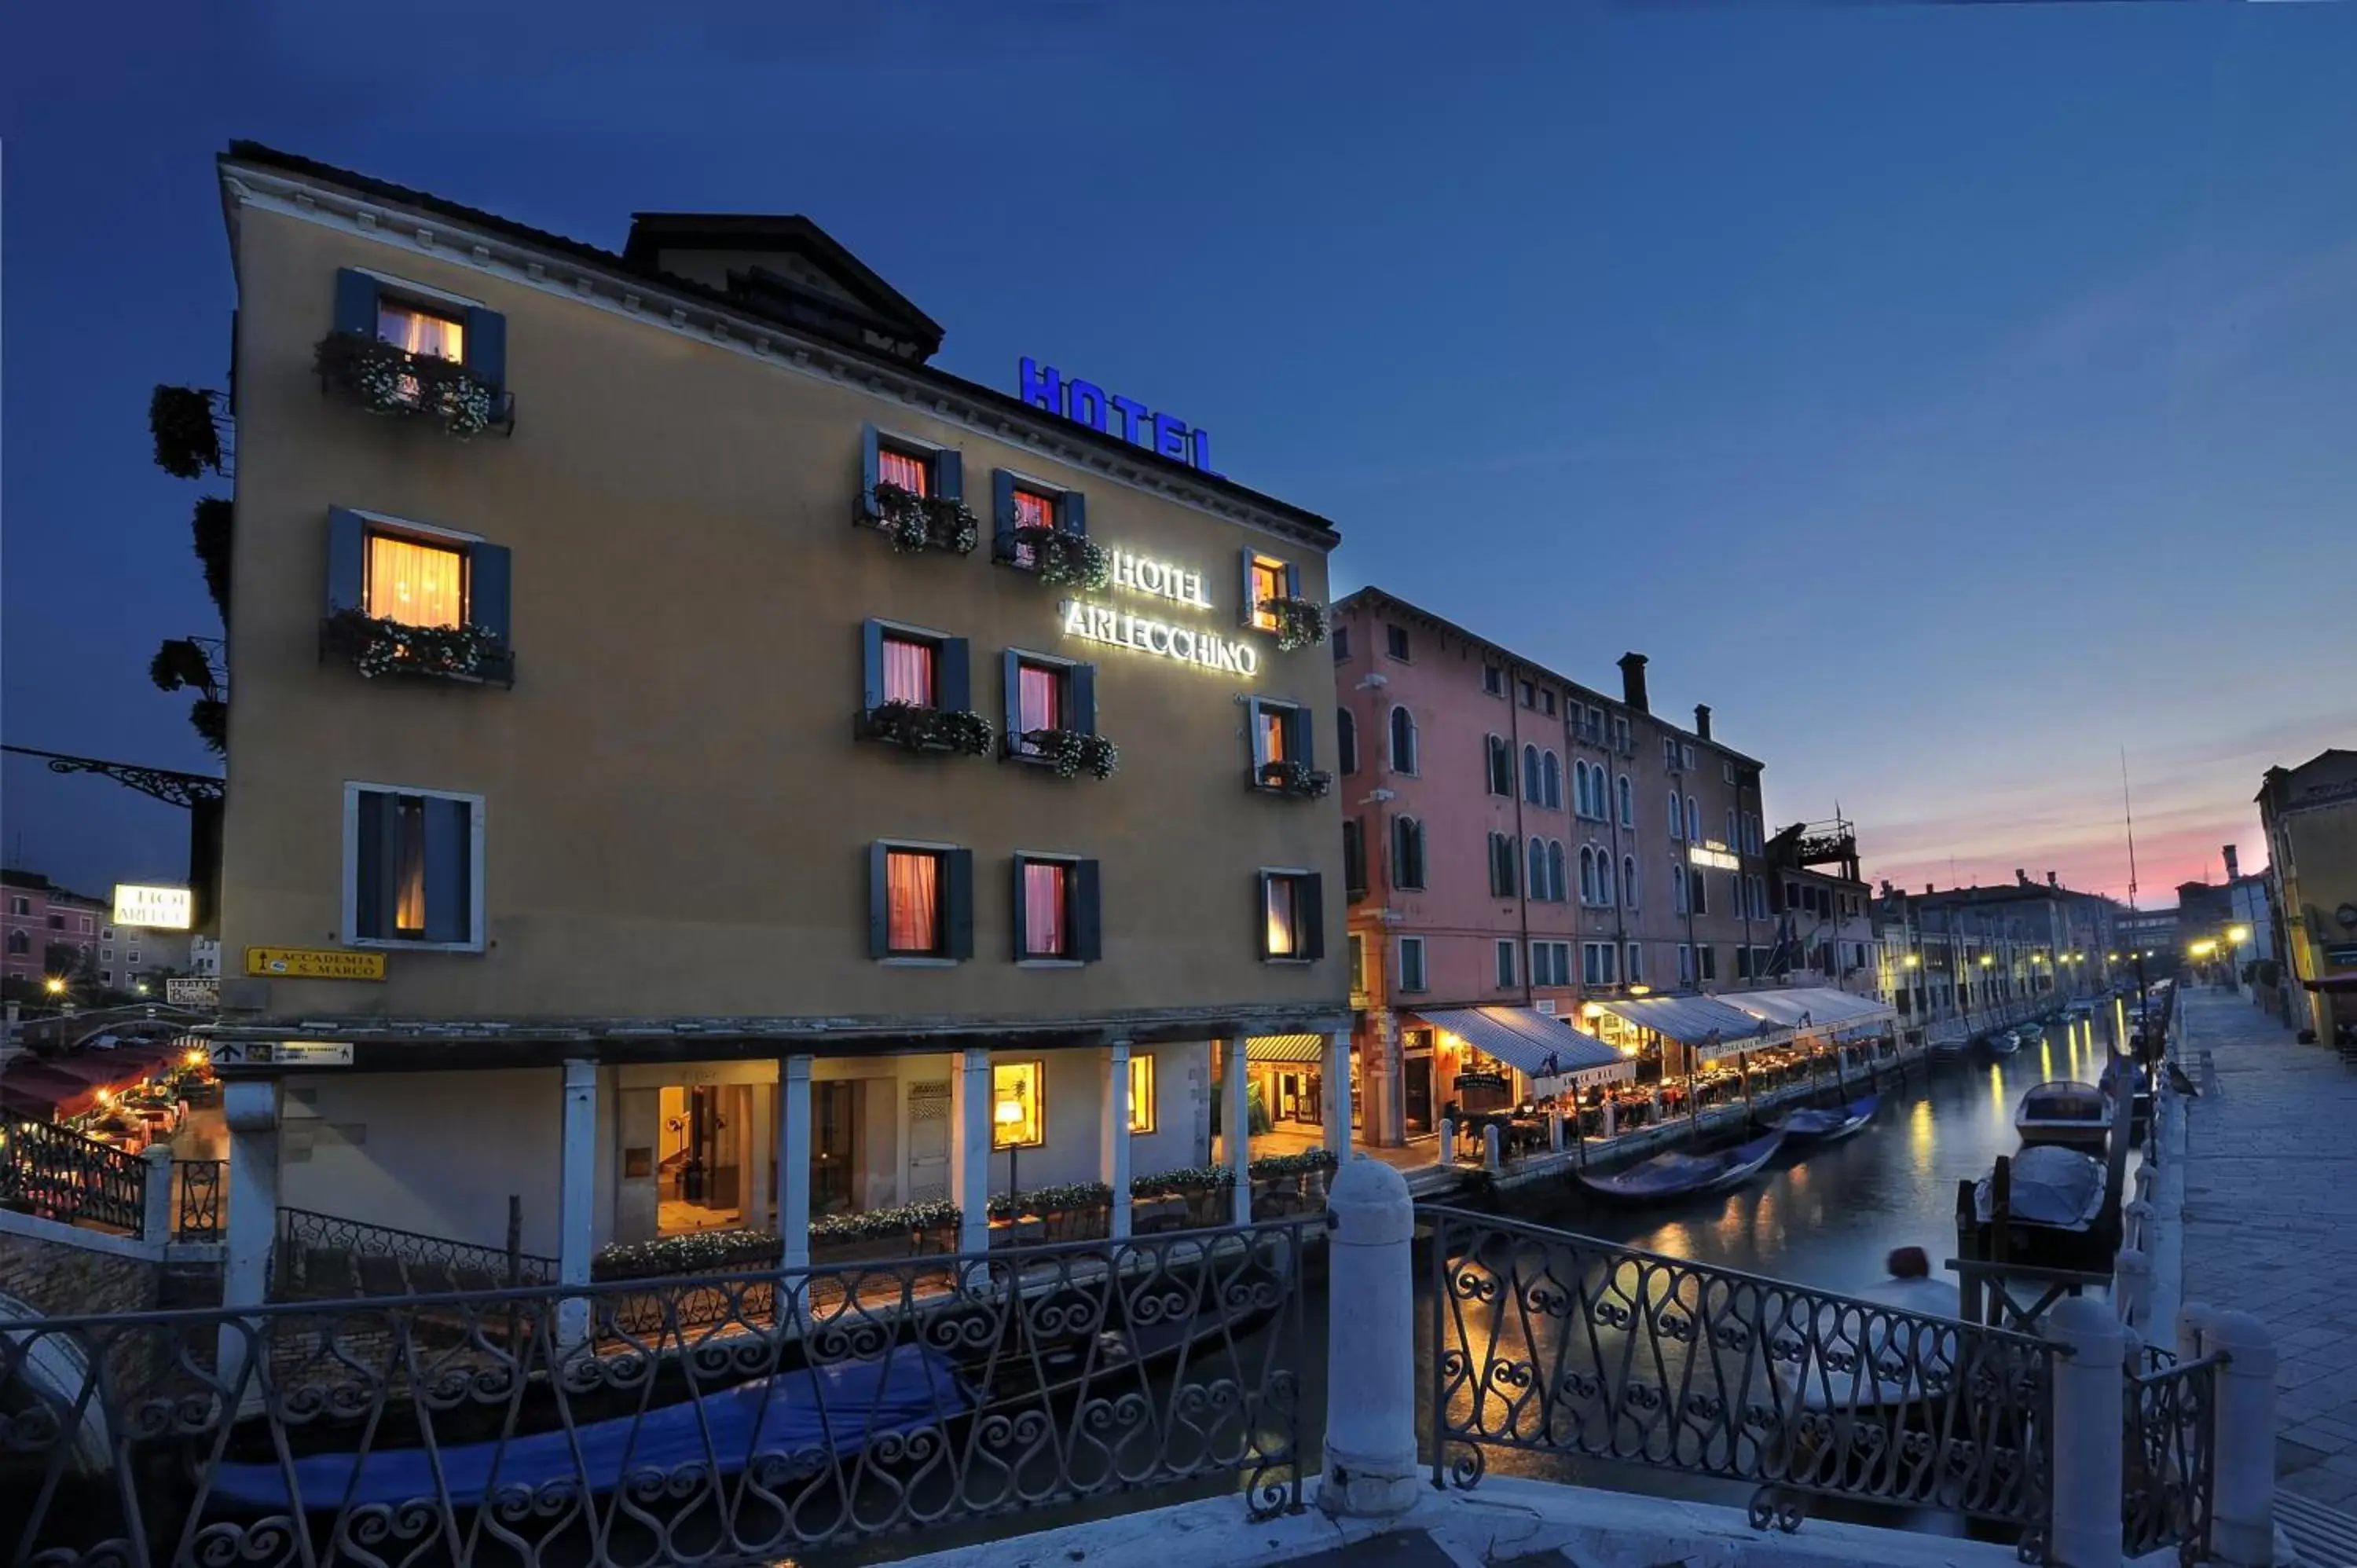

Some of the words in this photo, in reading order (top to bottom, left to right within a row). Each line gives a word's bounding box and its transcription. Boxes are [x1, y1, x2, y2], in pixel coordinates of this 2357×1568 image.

[1019, 356, 1227, 480] HOTEL
[1112, 548, 1215, 610] HOTEL
[1065, 599, 1259, 677] ARLECCHINO
[283, 952, 375, 966] ACCADEMIA
[315, 965, 376, 976] MARCO
